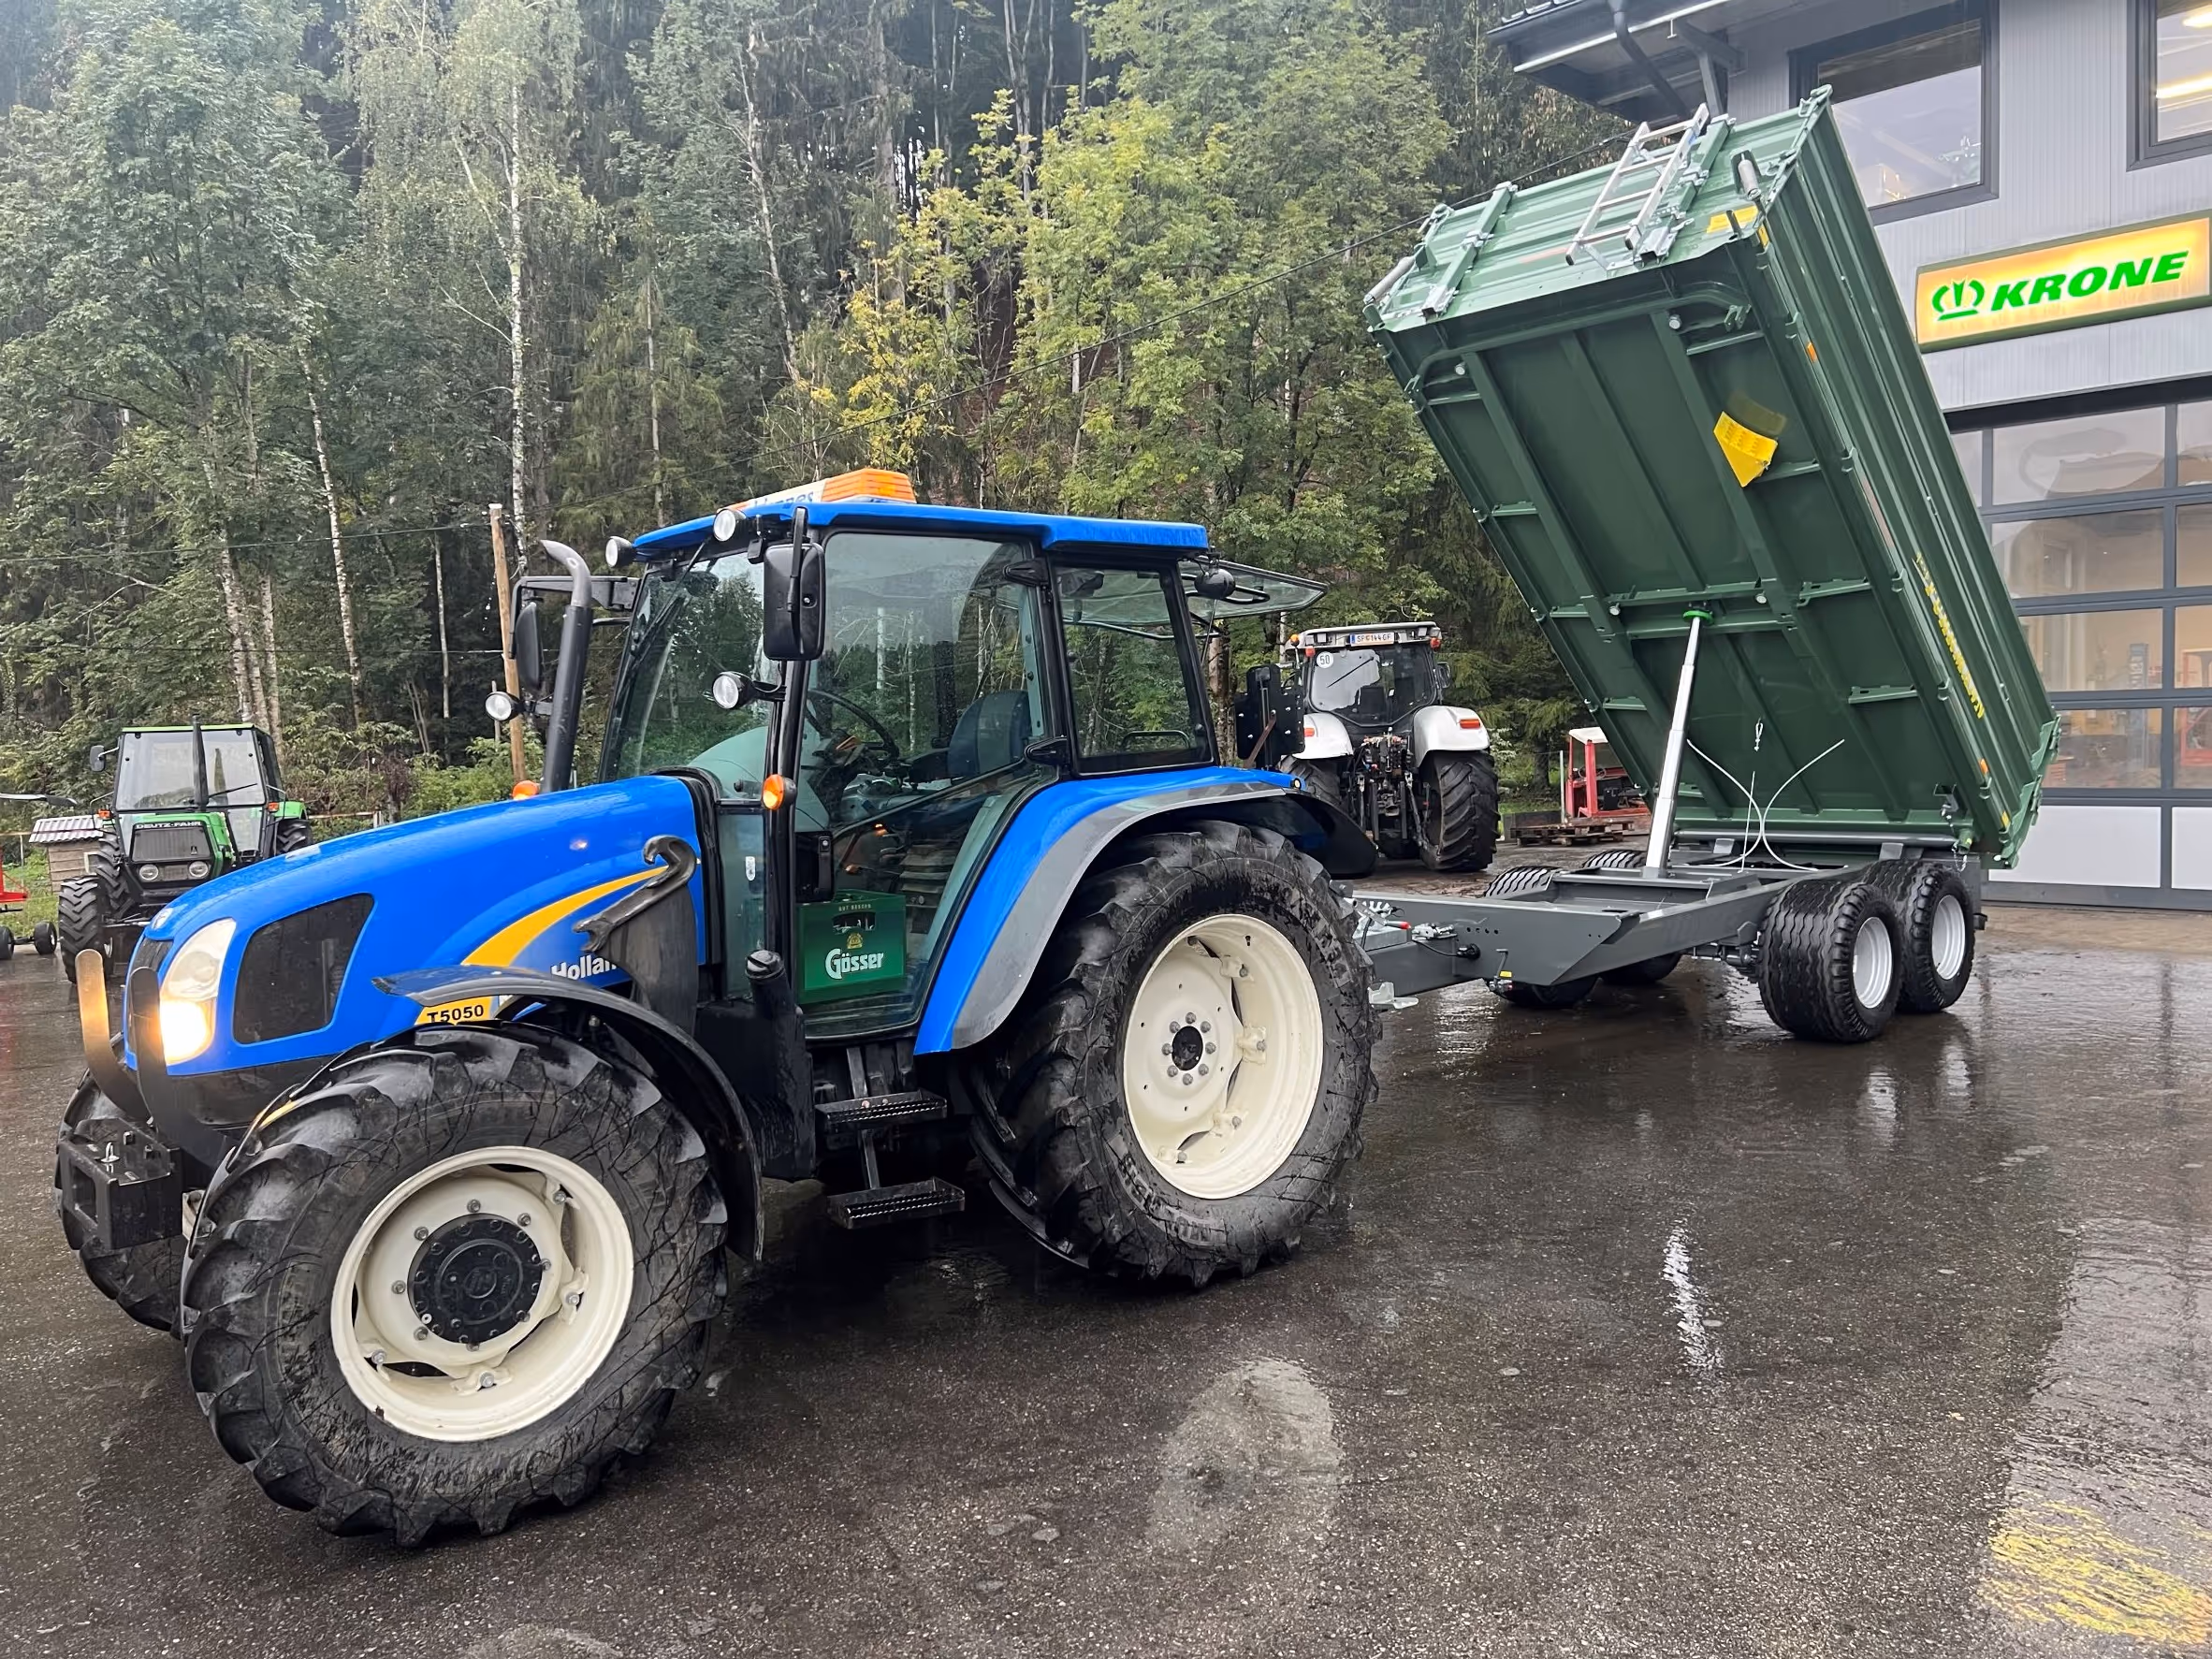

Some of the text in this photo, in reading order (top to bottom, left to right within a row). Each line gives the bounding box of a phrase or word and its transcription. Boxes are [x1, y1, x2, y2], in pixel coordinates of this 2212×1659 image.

[1990, 250, 2190, 312] KRONE
[1319, 654, 1331, 665] 50
[551, 954, 618, 981] Hollan
[824, 948, 884, 980] Gösser
[427, 1004, 485, 1024] T5050
